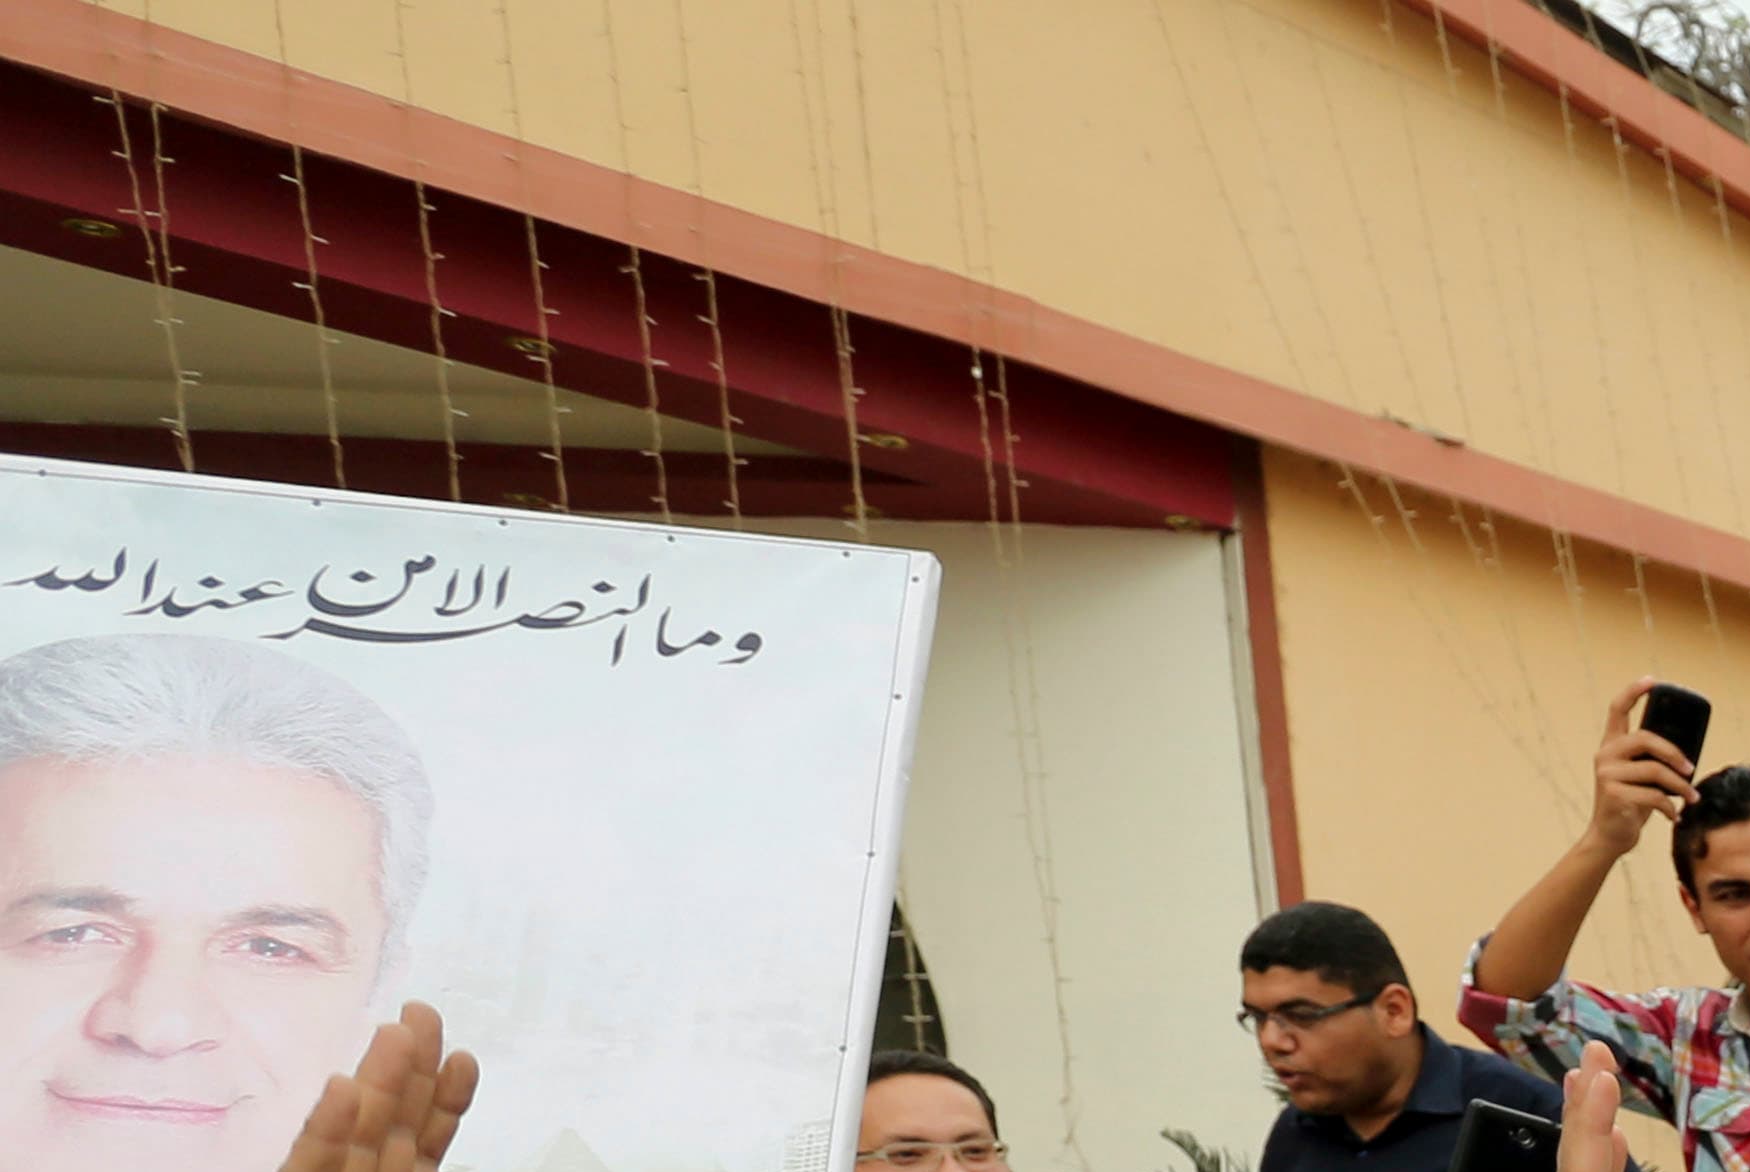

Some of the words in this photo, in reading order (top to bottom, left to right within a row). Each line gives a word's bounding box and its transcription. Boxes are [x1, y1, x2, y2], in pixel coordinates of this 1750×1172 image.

[2, 546, 160, 604] الله
[121, 573, 296, 619] عند
[306, 554, 437, 618] من
[257, 572, 652, 668] النصر
[656, 605, 763, 666] وما
